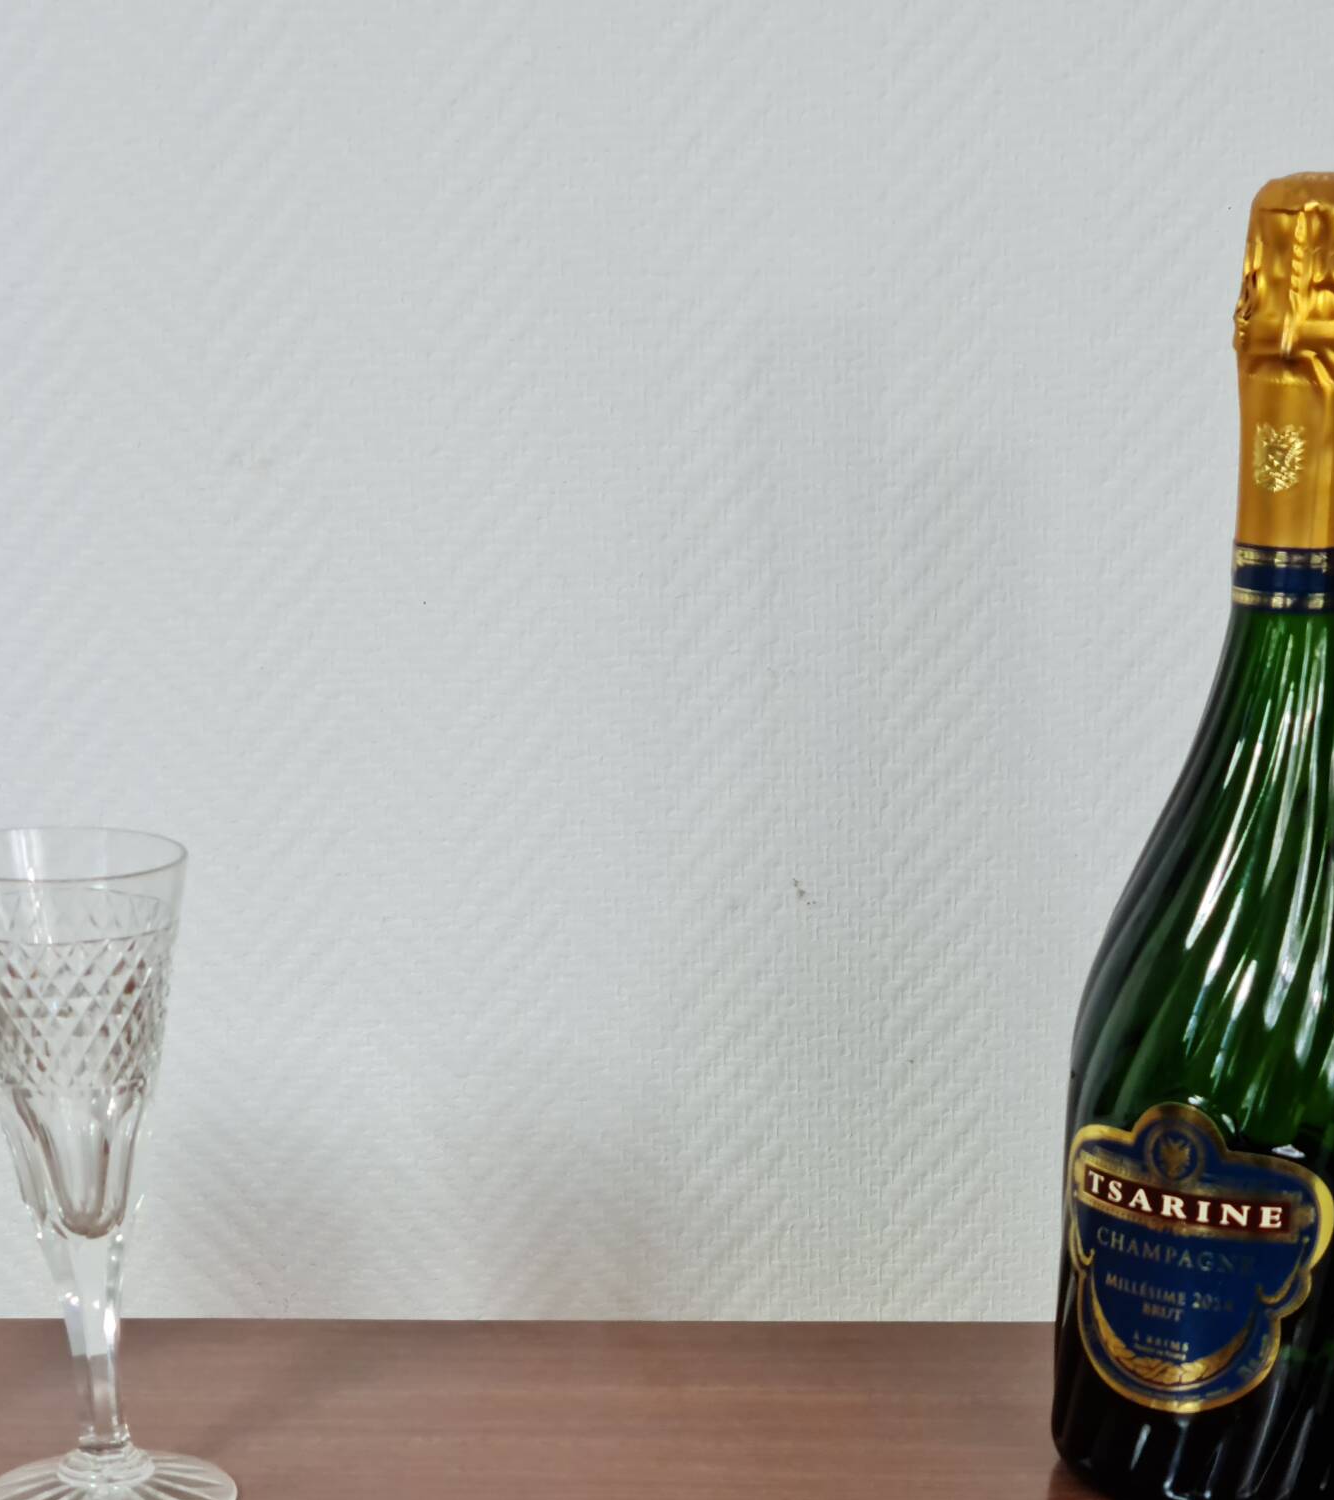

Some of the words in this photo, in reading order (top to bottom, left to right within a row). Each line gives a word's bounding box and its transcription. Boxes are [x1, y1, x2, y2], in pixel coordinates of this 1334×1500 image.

[1088, 1170, 1283, 1229] TSARINE
[1105, 1271, 1187, 1308] MILLÉSIME
[1142, 1302, 1185, 1323] BRUT
